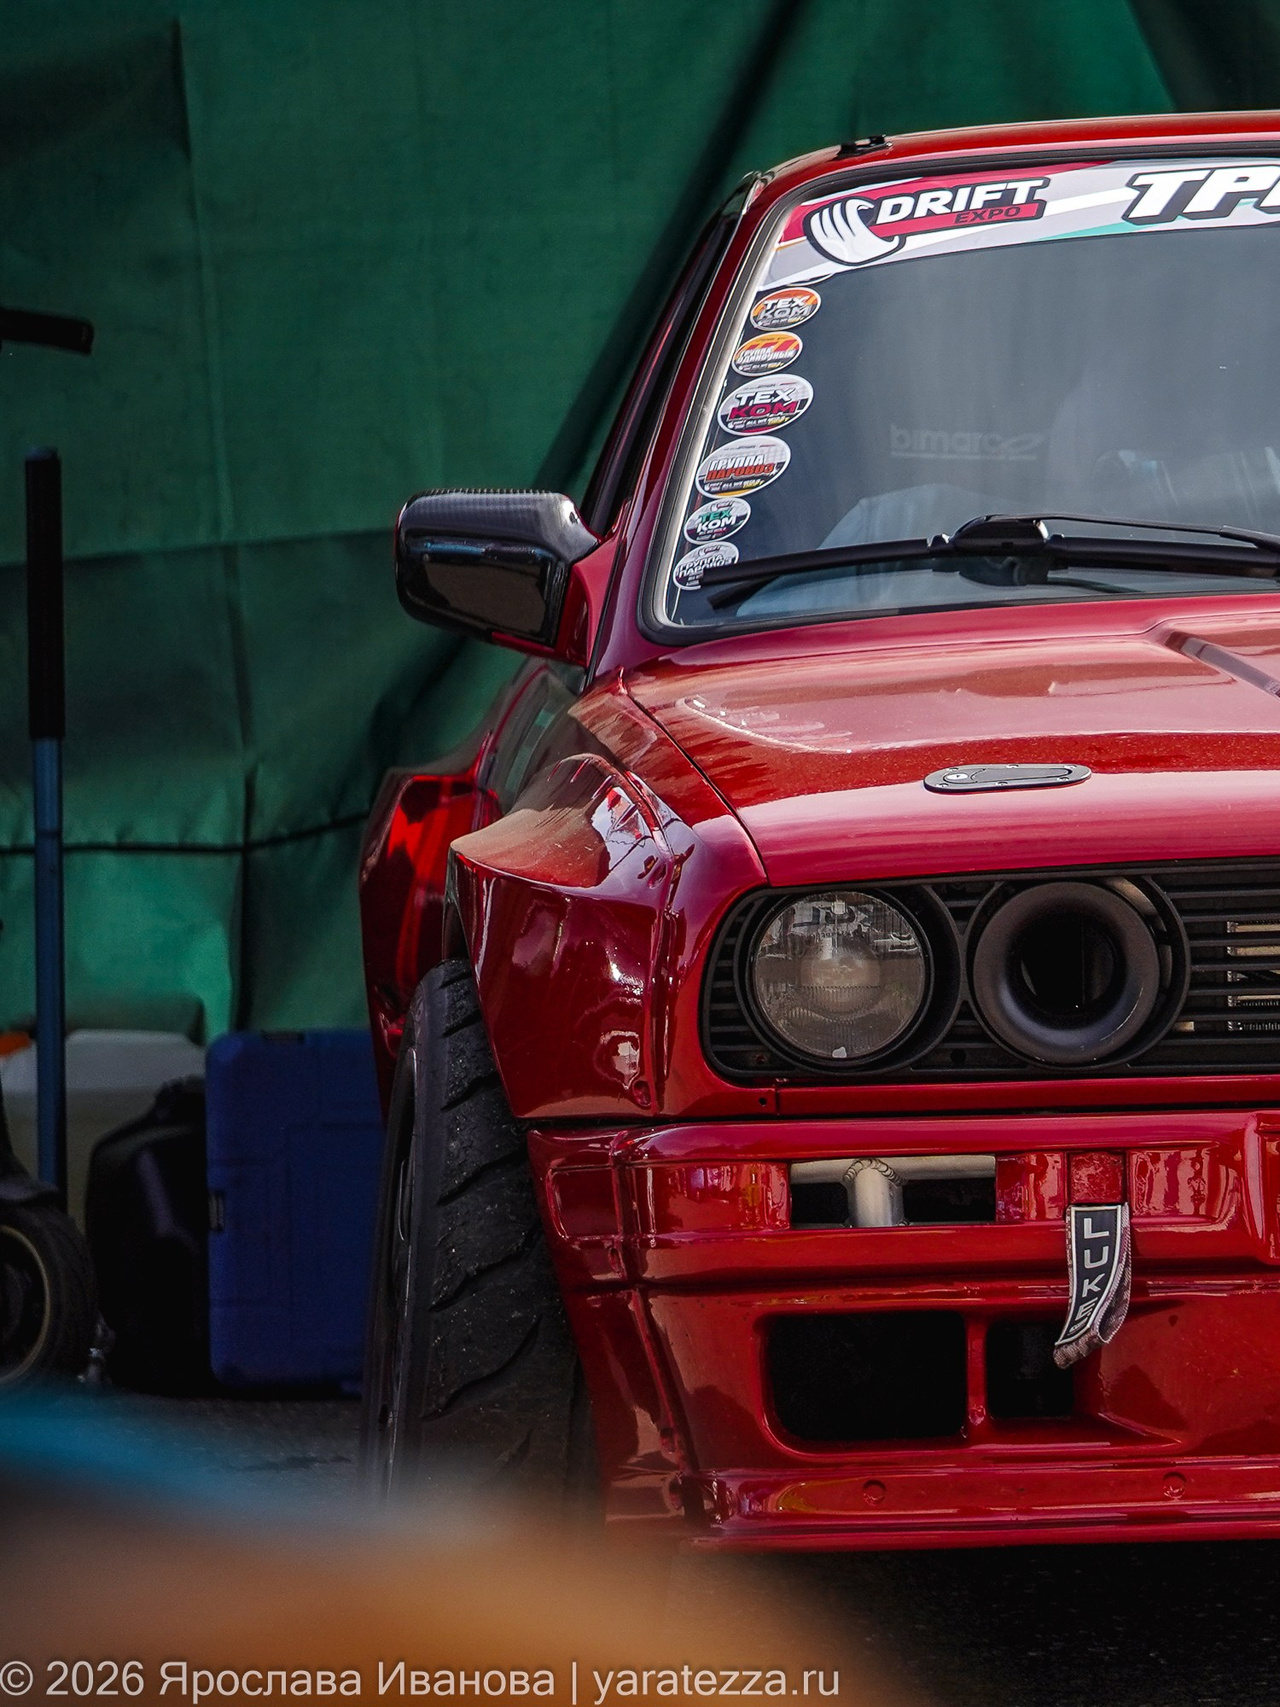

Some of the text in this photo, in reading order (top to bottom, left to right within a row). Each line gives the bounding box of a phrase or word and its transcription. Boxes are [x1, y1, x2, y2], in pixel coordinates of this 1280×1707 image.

[875, 179, 1045, 225] DRIFT
[954, 206, 1021, 225] EXPO
[706, 462, 776, 480] ПАРОВОЗ
[709, 454, 765, 471] ГРУППА
